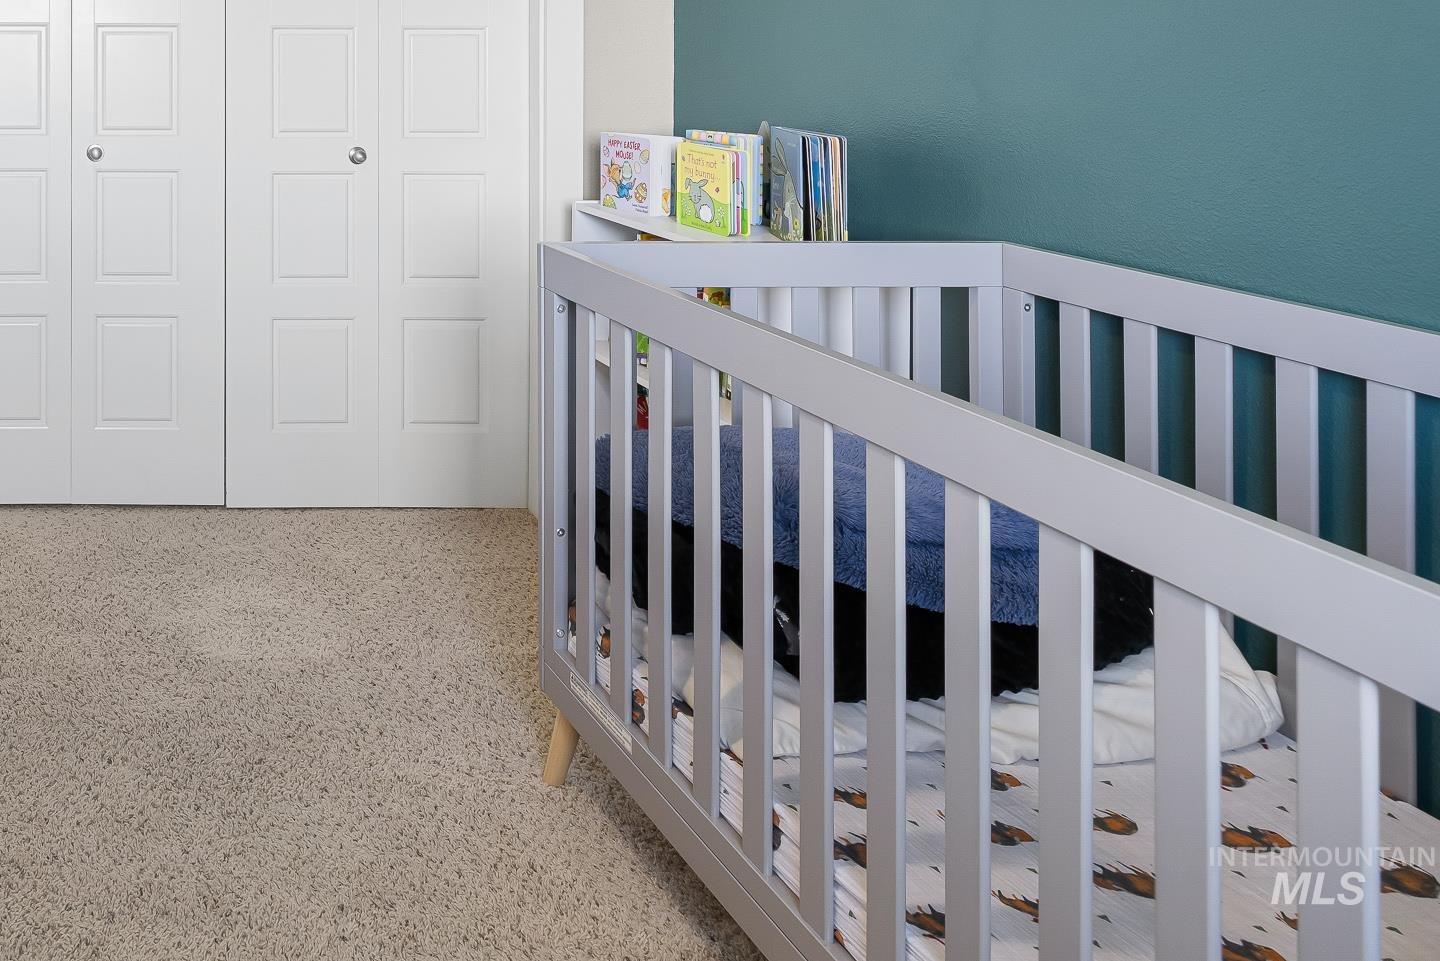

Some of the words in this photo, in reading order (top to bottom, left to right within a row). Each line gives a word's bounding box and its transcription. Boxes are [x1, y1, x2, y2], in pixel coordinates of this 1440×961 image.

[607, 138, 622, 148] HAPPY
[623, 140, 641, 151] EASTER
[615, 150, 634, 160] MOUSE!
[687, 153, 705, 166] That's
[706, 160, 717, 169] not
